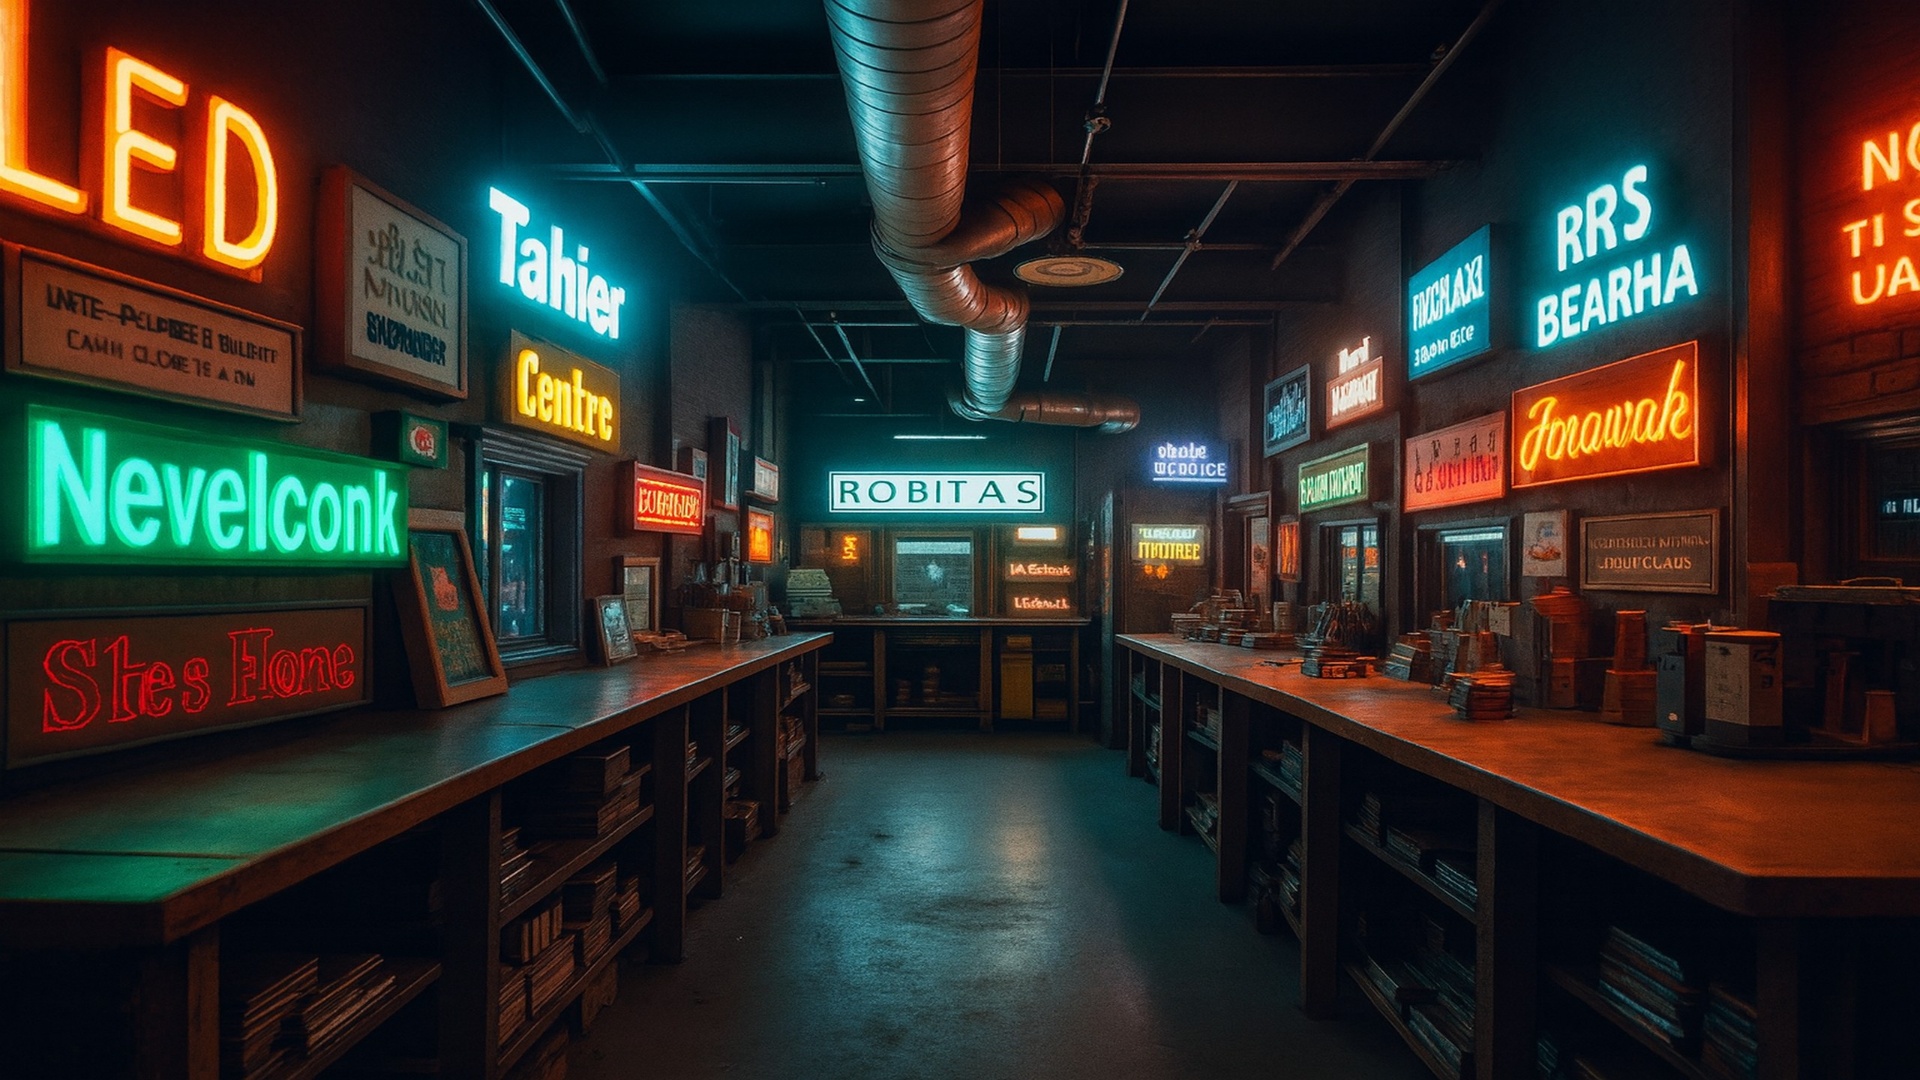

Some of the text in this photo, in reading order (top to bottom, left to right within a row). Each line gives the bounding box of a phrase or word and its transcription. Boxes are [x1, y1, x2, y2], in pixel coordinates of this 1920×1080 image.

[489, 186, 625, 339] Tahier
[1557, 164, 1652, 272] RRS
[1537, 244, 1698, 347] BEARHA
[516, 349, 613, 441] Centre
[35, 419, 400, 556] Nevelconk
[839, 480, 1038, 504] ROBITAS
